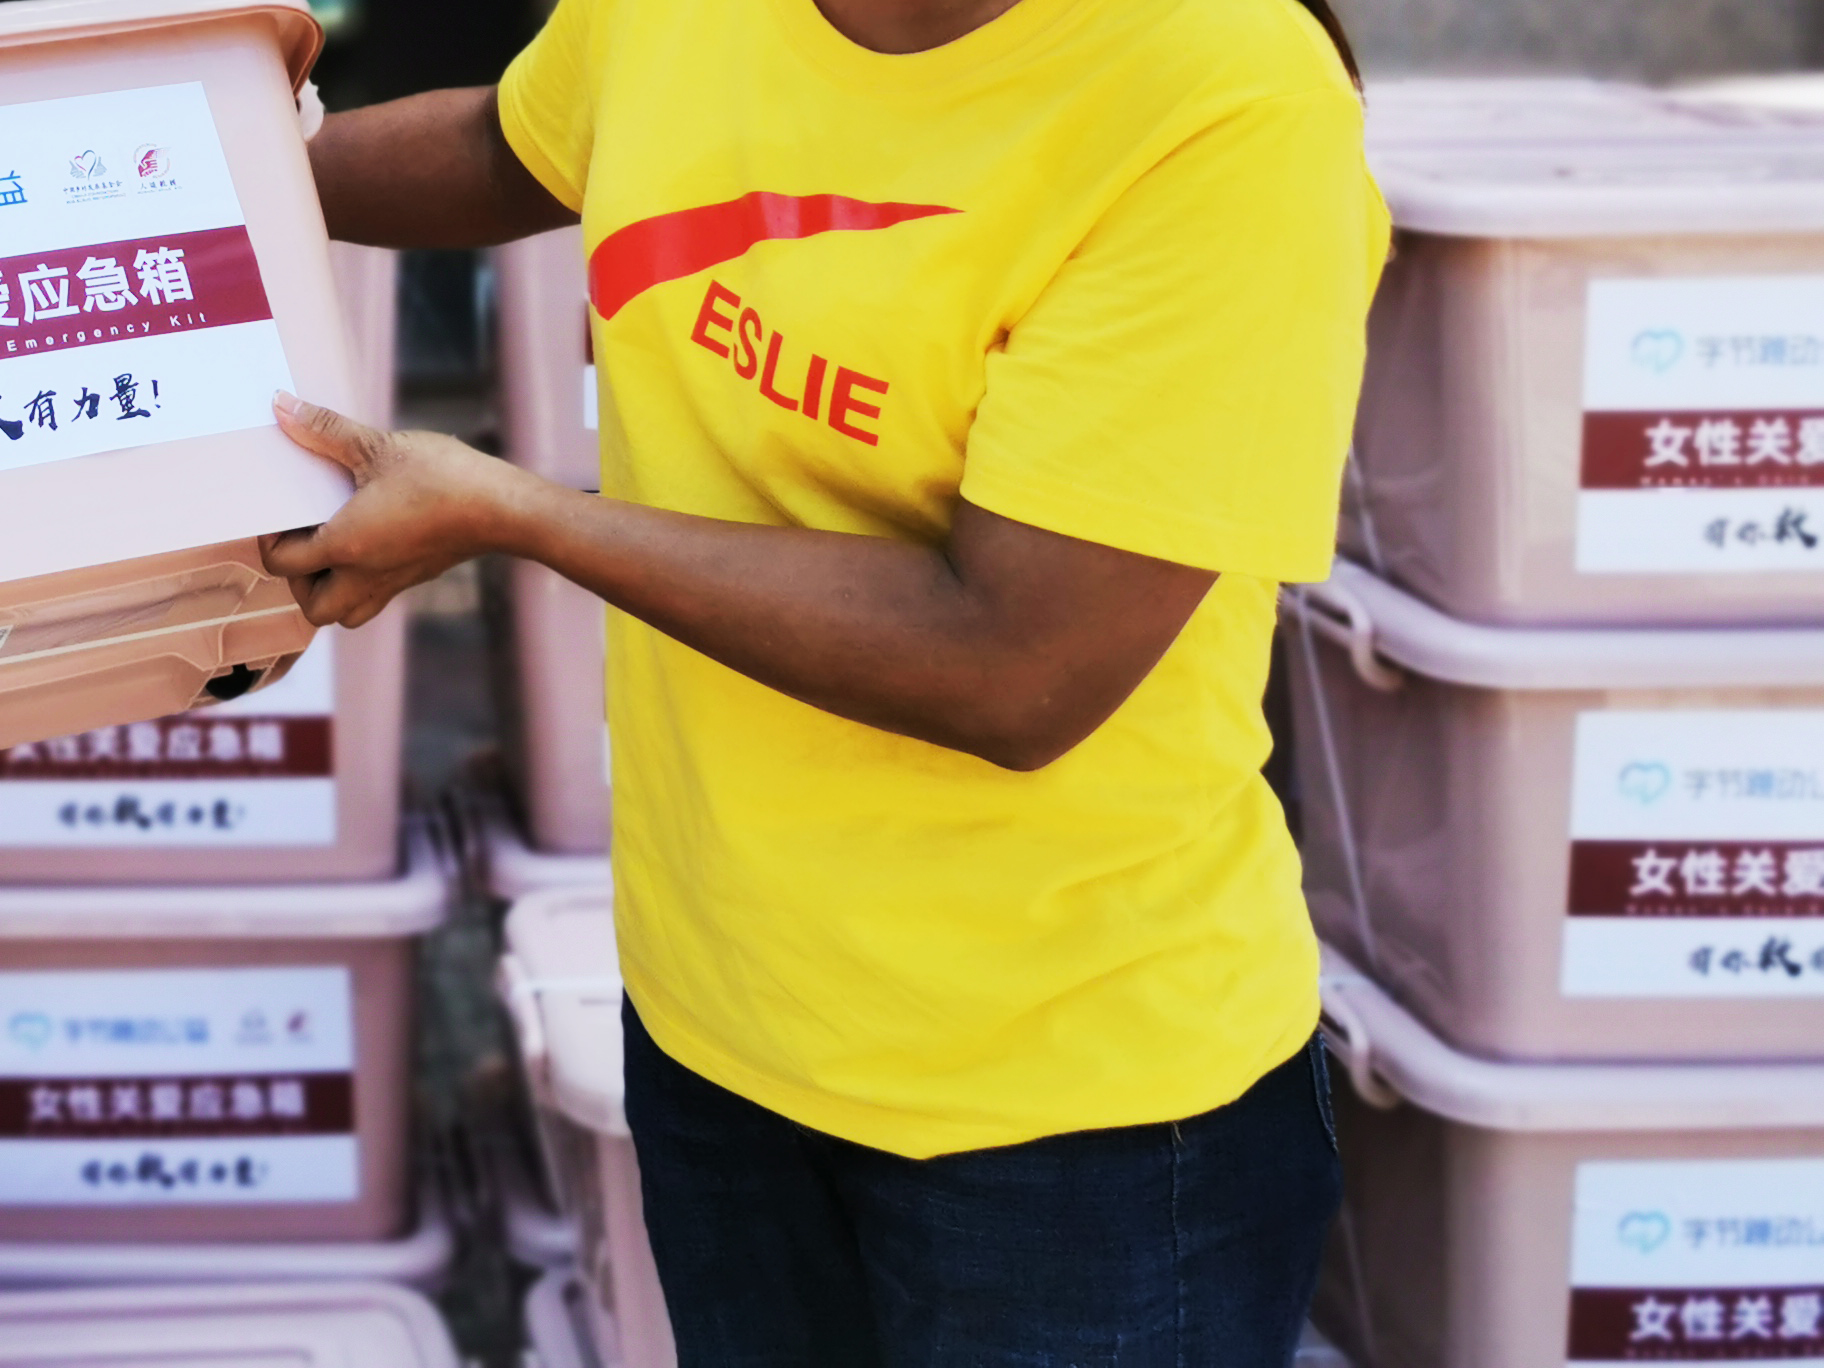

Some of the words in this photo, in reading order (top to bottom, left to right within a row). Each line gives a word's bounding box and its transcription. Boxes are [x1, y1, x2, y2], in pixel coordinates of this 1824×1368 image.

[6, 321, 152, 354] Emergency
[169, 311, 207, 329] Kit
[690, 279, 889, 446] ESLIE
[1629, 848, 1824, 898] 女性关爱
